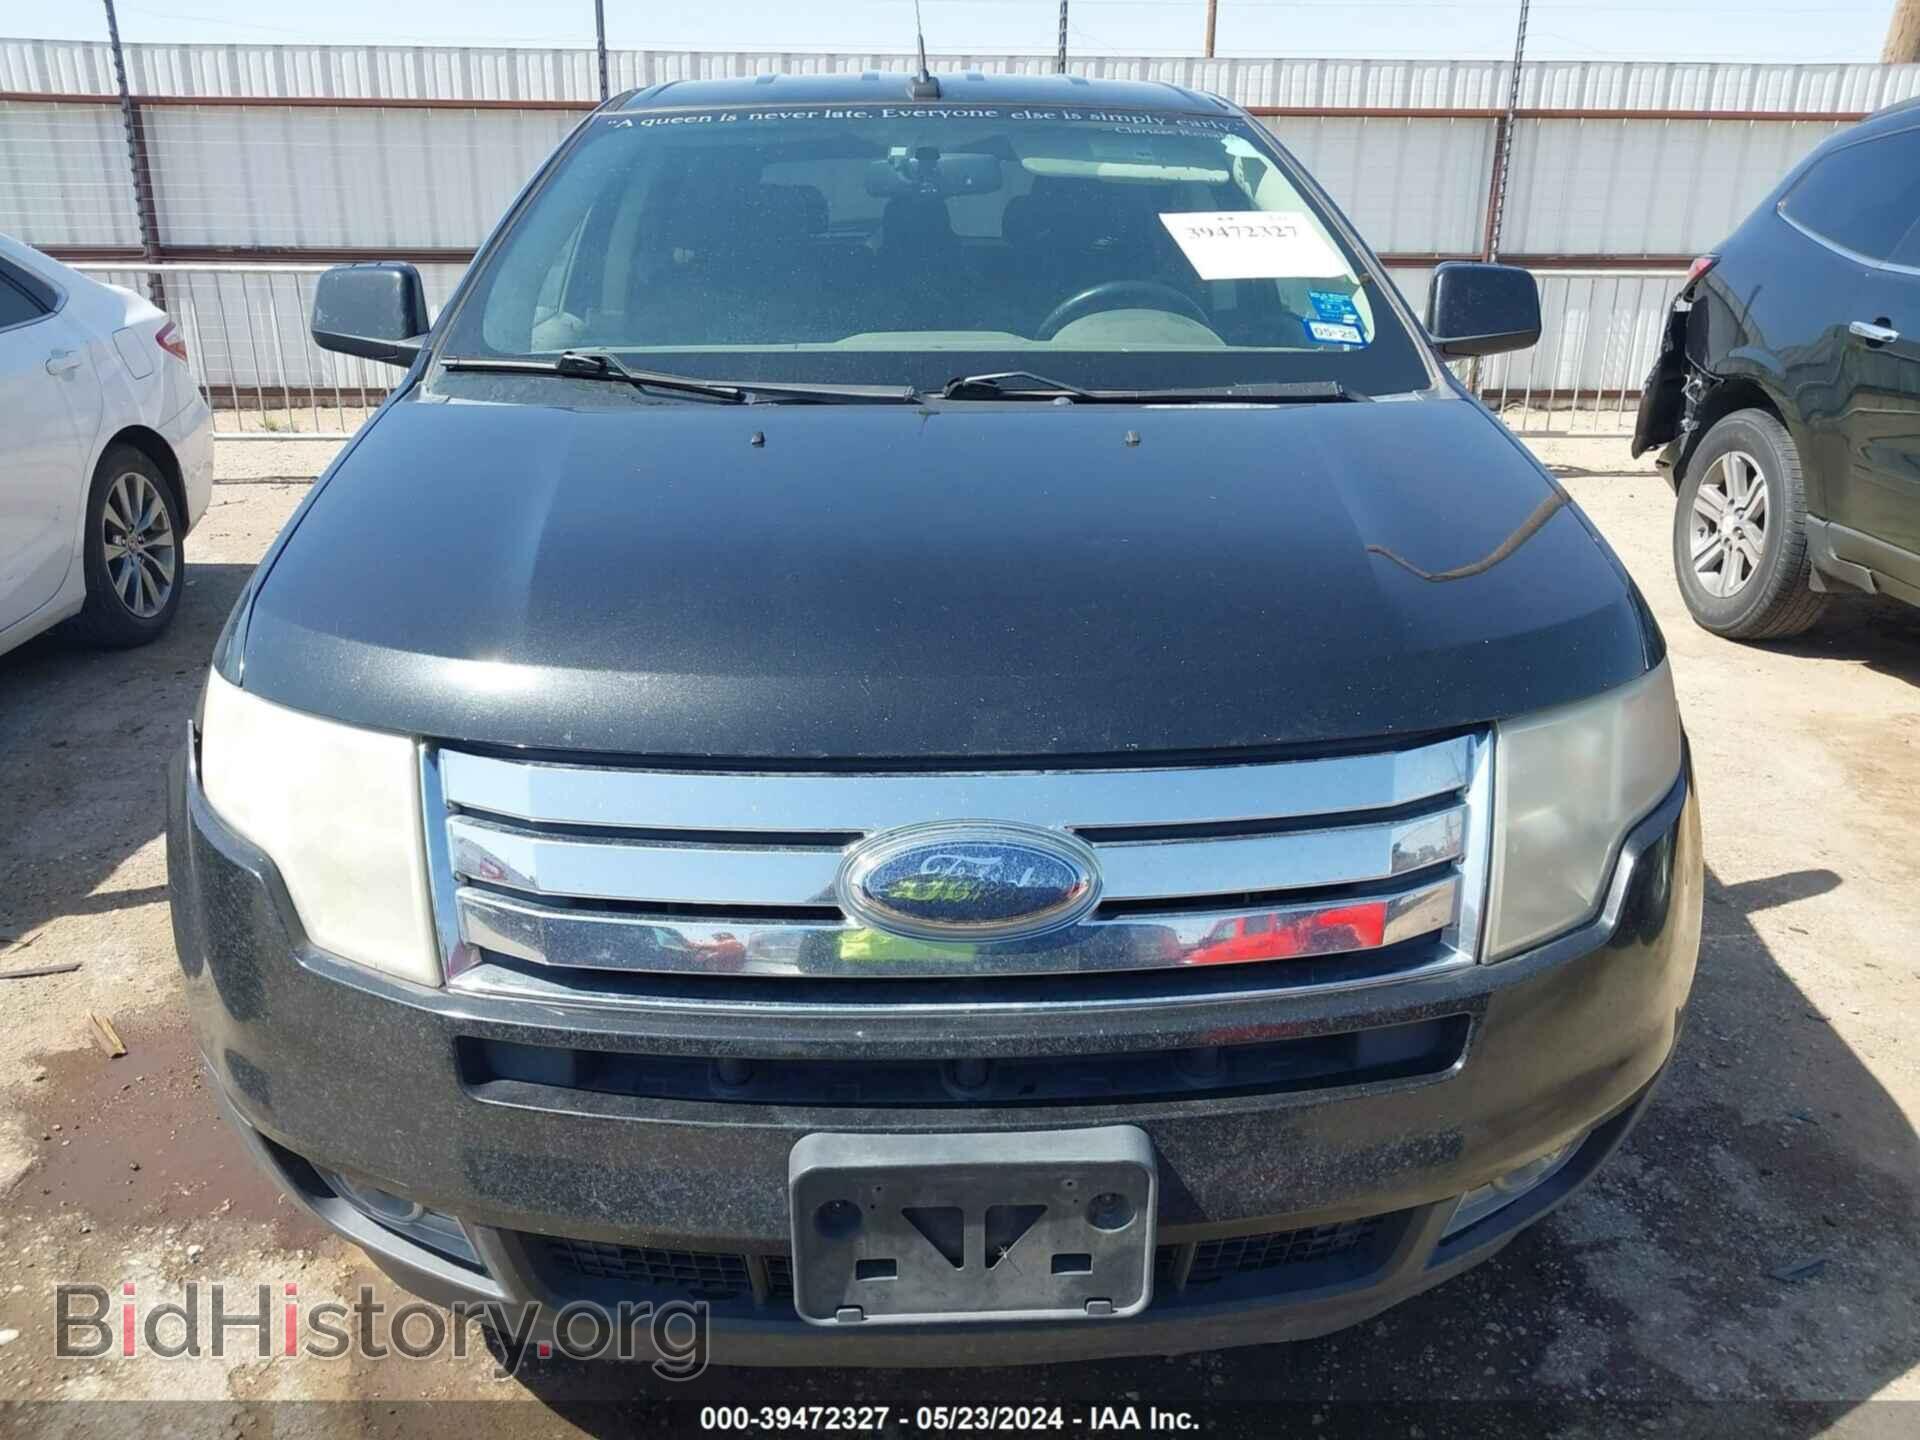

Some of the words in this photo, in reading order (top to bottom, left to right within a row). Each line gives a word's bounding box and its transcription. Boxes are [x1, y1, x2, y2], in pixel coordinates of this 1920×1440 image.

[640, 115, 712, 128] queen
[719, 113, 737, 122] is
[748, 111, 820, 121] never
[824, 109, 873, 119] late.
[881, 108, 1000, 119] Everyone
[1010, 110, 1057, 120] else
[1060, 110, 1083, 120] is
[1089, 111, 1166, 126] simply
